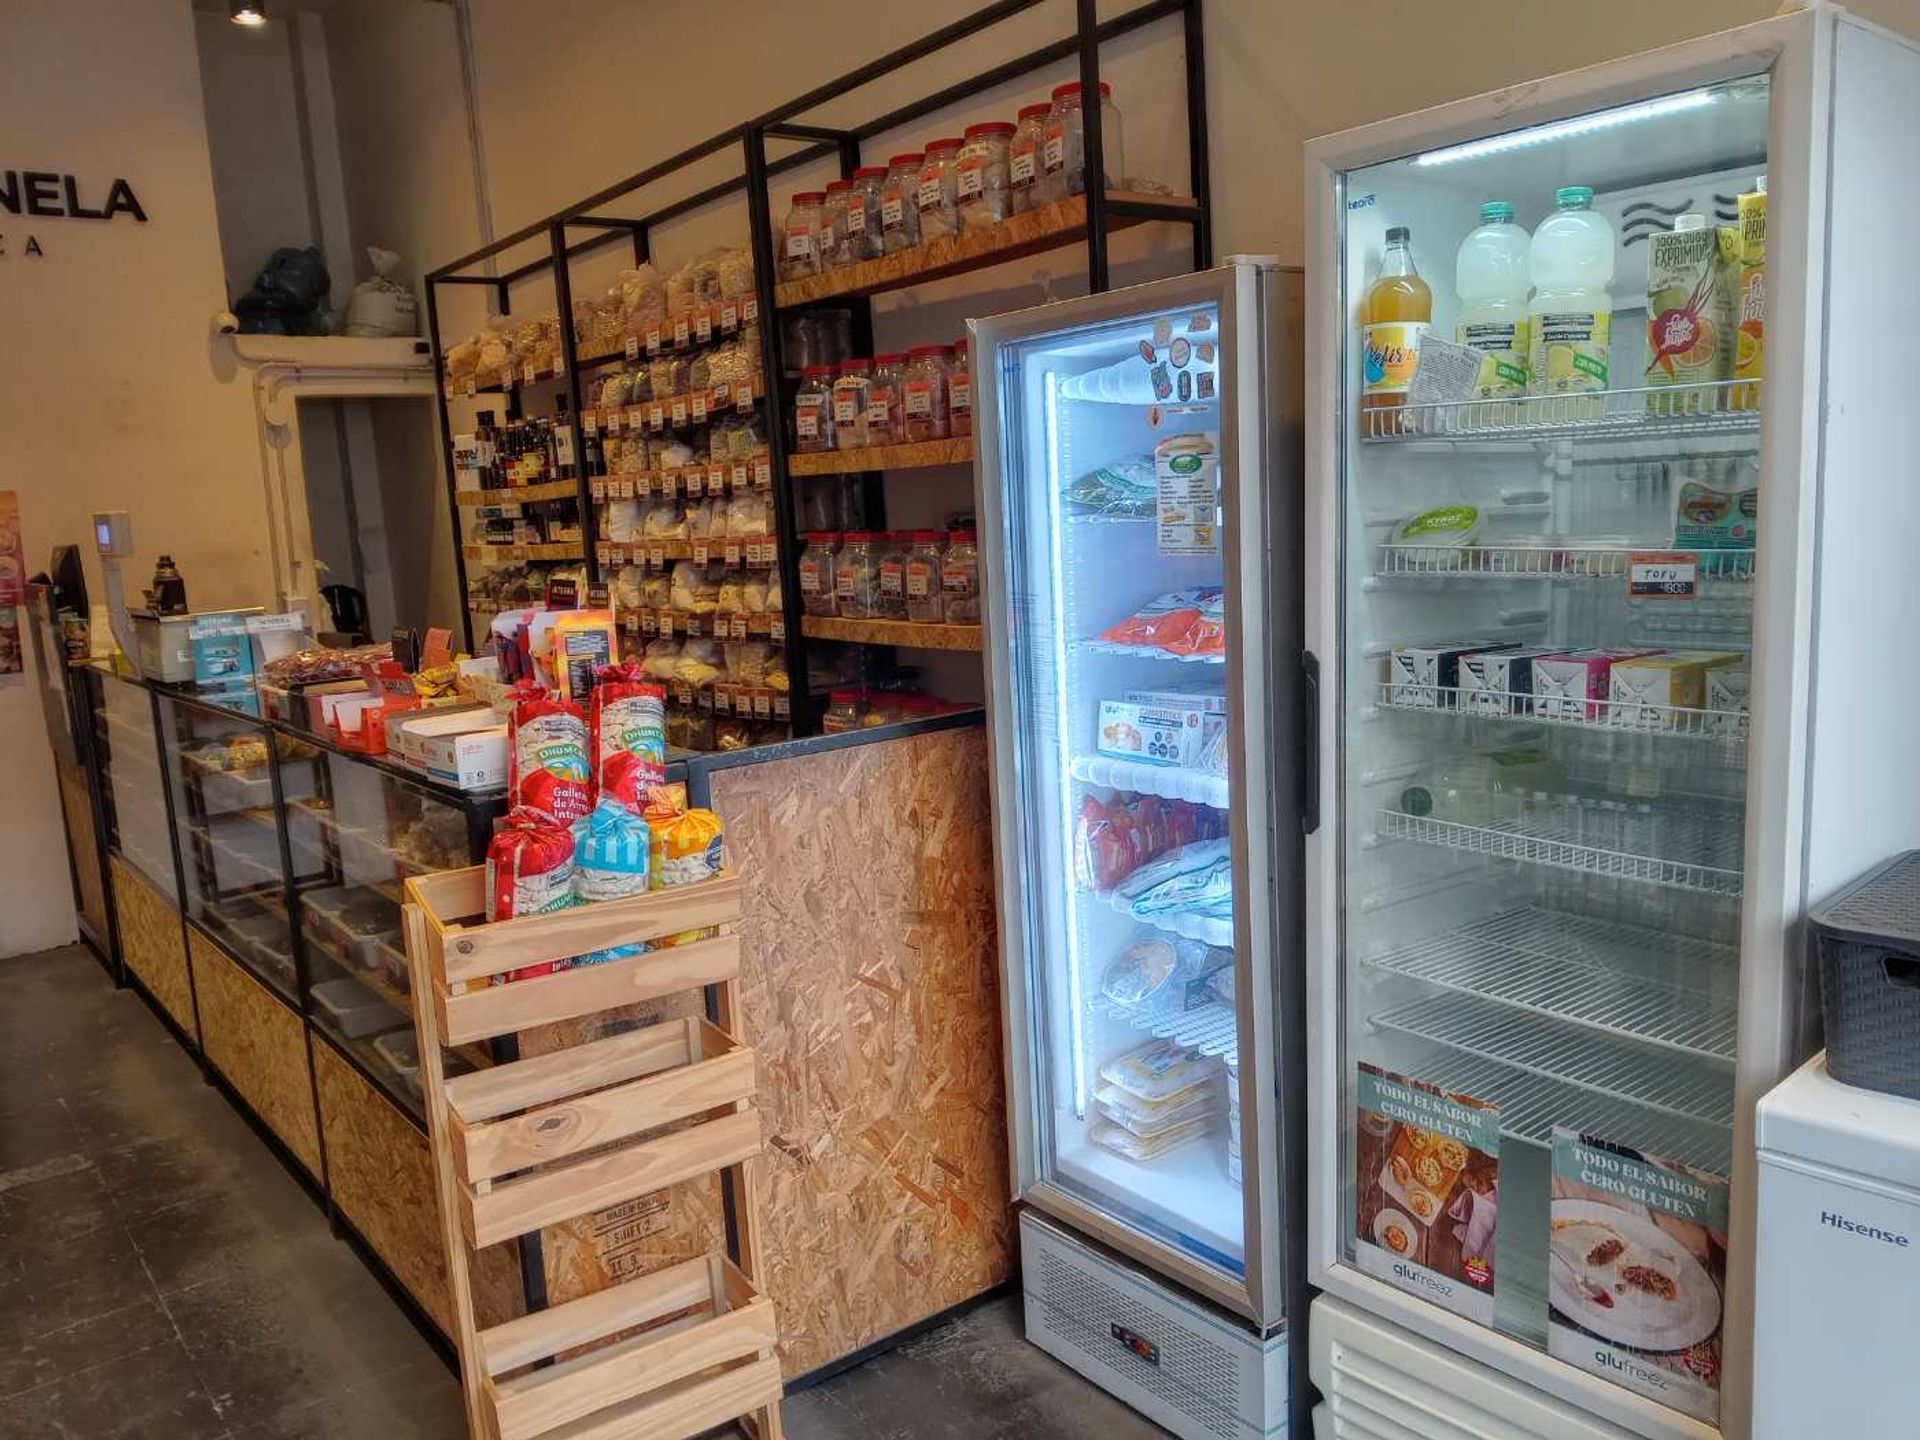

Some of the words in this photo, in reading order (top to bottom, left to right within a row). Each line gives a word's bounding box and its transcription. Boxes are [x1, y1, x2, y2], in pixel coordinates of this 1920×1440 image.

[1643, 569, 1677, 581] TOFU
[1373, 1079, 1411, 1104] TODO
[1414, 1094, 1431, 1111] EL
[1432, 1100, 1483, 1129] SABOR
[1380, 1101, 1417, 1123] CERO
[1419, 1114, 1474, 1143] GLUTEN
[1571, 1147, 1620, 1173] TODO
[1623, 1163, 1644, 1182] EL
[1645, 1172, 1708, 1202] SABOR
[1580, 1168, 1625, 1194] CERO
[1628, 1185, 1696, 1218] GLUTEN
[1821, 1211, 1911, 1248] Hisense
[1594, 1350, 1670, 1392] glufreez
